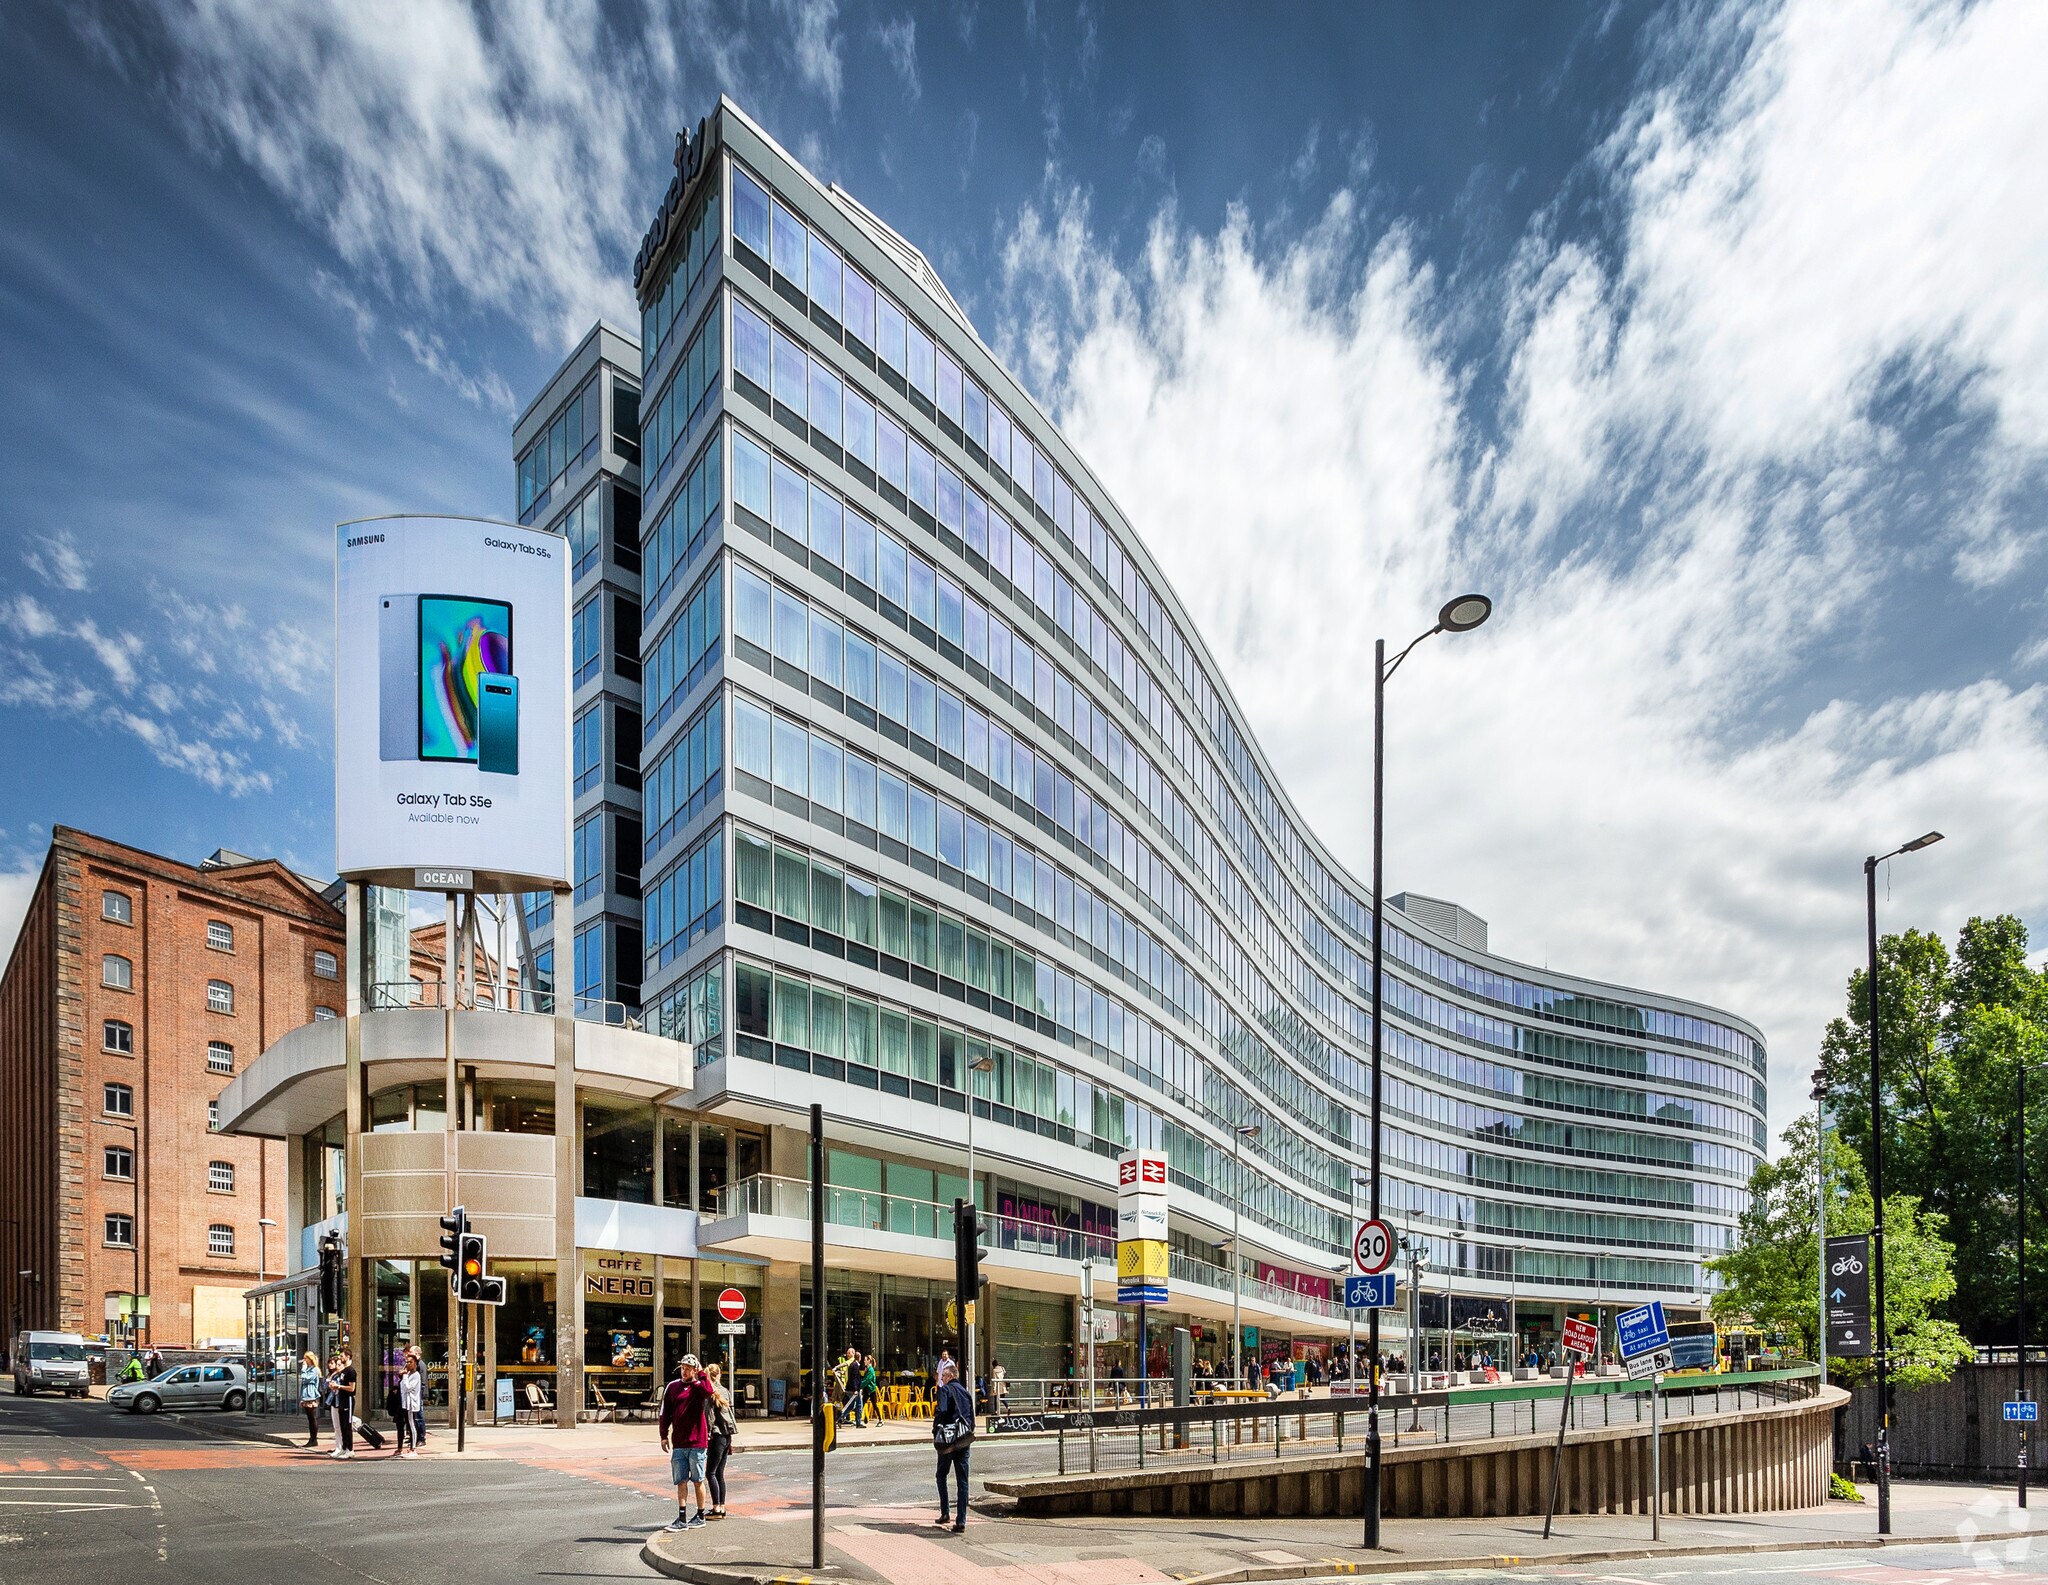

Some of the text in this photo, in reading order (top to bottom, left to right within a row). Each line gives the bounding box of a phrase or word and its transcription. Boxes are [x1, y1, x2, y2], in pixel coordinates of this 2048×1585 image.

[347, 534, 385, 548] SAMSUNG
[484, 537, 518, 553] Galaxy
[518, 543, 536, 555] Tab
[396, 793, 493, 809] Galaxy Tab S5e
[408, 812, 480, 824] Available now
[423, 872, 464, 885] OCEAN
[1360, 1235, 1385, 1259] 30
[599, 1257, 642, 1271] CAFFÈ
[586, 1274, 654, 1297] NERO
[1565, 1329, 1577, 1338] ROAD
[1576, 1324, 1586, 1333] NEW
[1637, 1326, 1648, 1334] taxi
[1571, 1340, 1586, 1349] AHEAD
[1629, 1336, 1660, 1352] At any time
[1629, 1358, 1652, 1370] Bus lane
[1631, 1365, 1654, 1376] cameras
